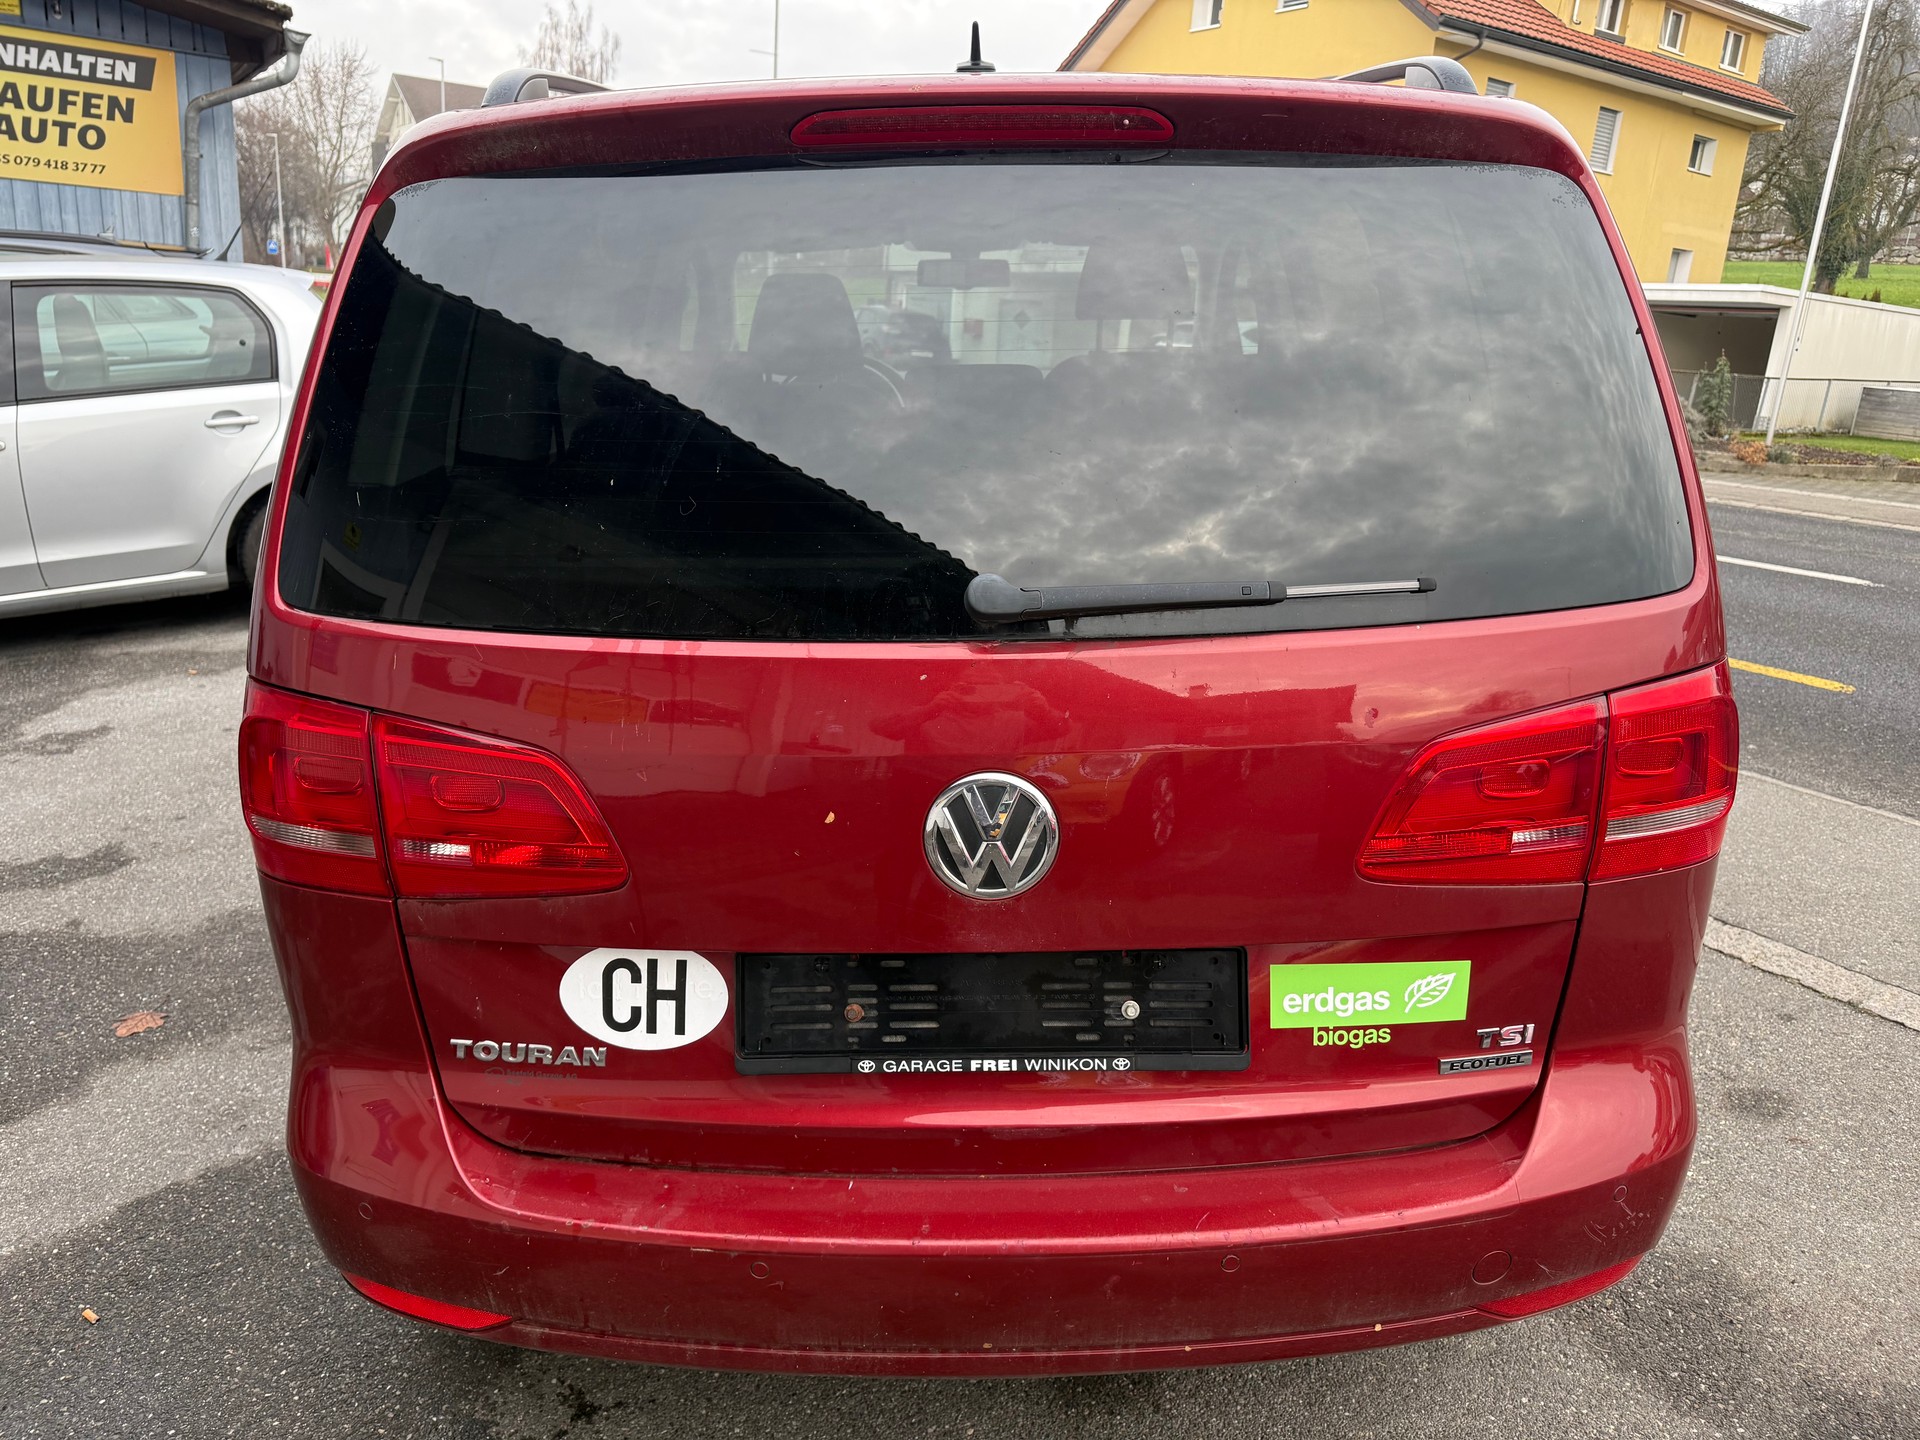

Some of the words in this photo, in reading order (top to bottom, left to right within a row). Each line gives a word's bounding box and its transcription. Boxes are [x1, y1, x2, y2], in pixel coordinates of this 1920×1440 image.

[0, 42, 136, 83] NHALTEN
[0, 81, 135, 124] AUFEN
[0, 113, 106, 151] AUTO
[13, 155, 41, 167] 079
[43, 158, 69, 171] 418
[602, 957, 688, 1036] CH
[1282, 986, 1391, 1018] erdgas
[1312, 1026, 1392, 1049] biogas
[1476, 1023, 1535, 1049] TSI
[450, 1038, 607, 1067] TOURAN
[883, 1059, 963, 1072] GARAGE
[970, 1059, 1018, 1072] FREI
[1024, 1058, 1107, 1071] WINIKON
